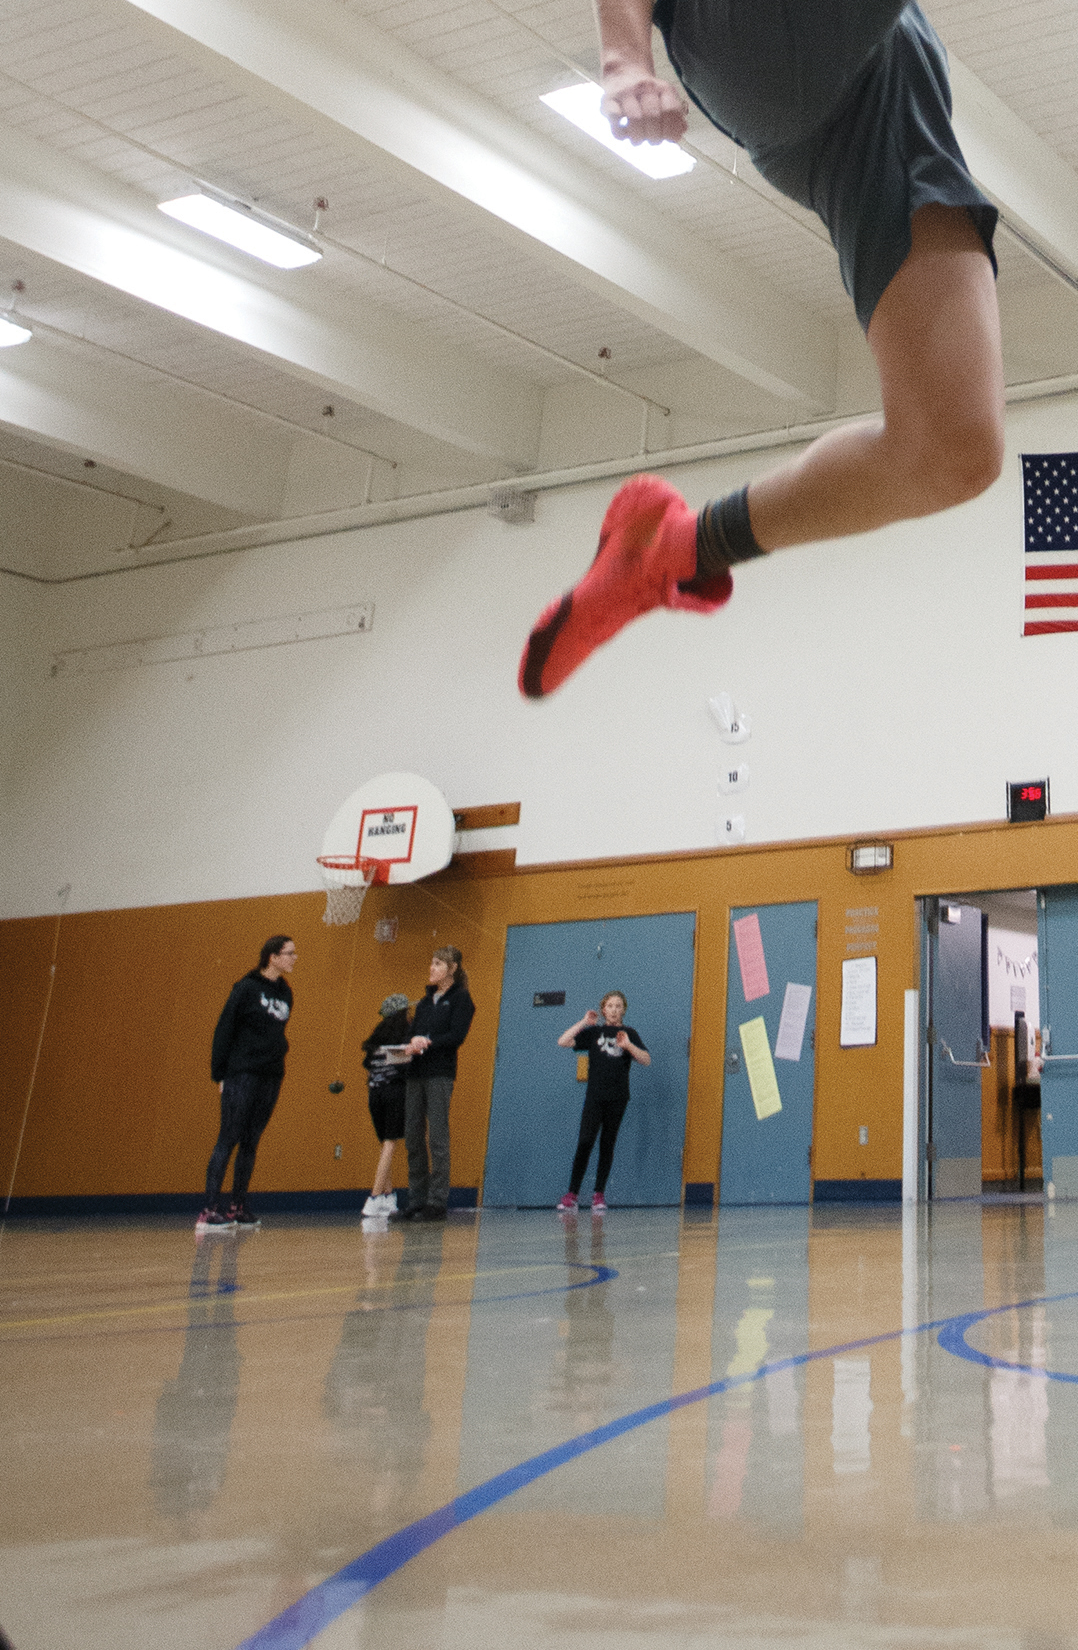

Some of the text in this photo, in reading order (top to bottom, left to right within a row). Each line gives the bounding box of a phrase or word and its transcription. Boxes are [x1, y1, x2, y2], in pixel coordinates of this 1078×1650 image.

[728, 770, 738, 783] 10
[383, 813, 394, 822] NO
[368, 823, 406, 836] HANGING
[726, 820, 732, 831] 5
